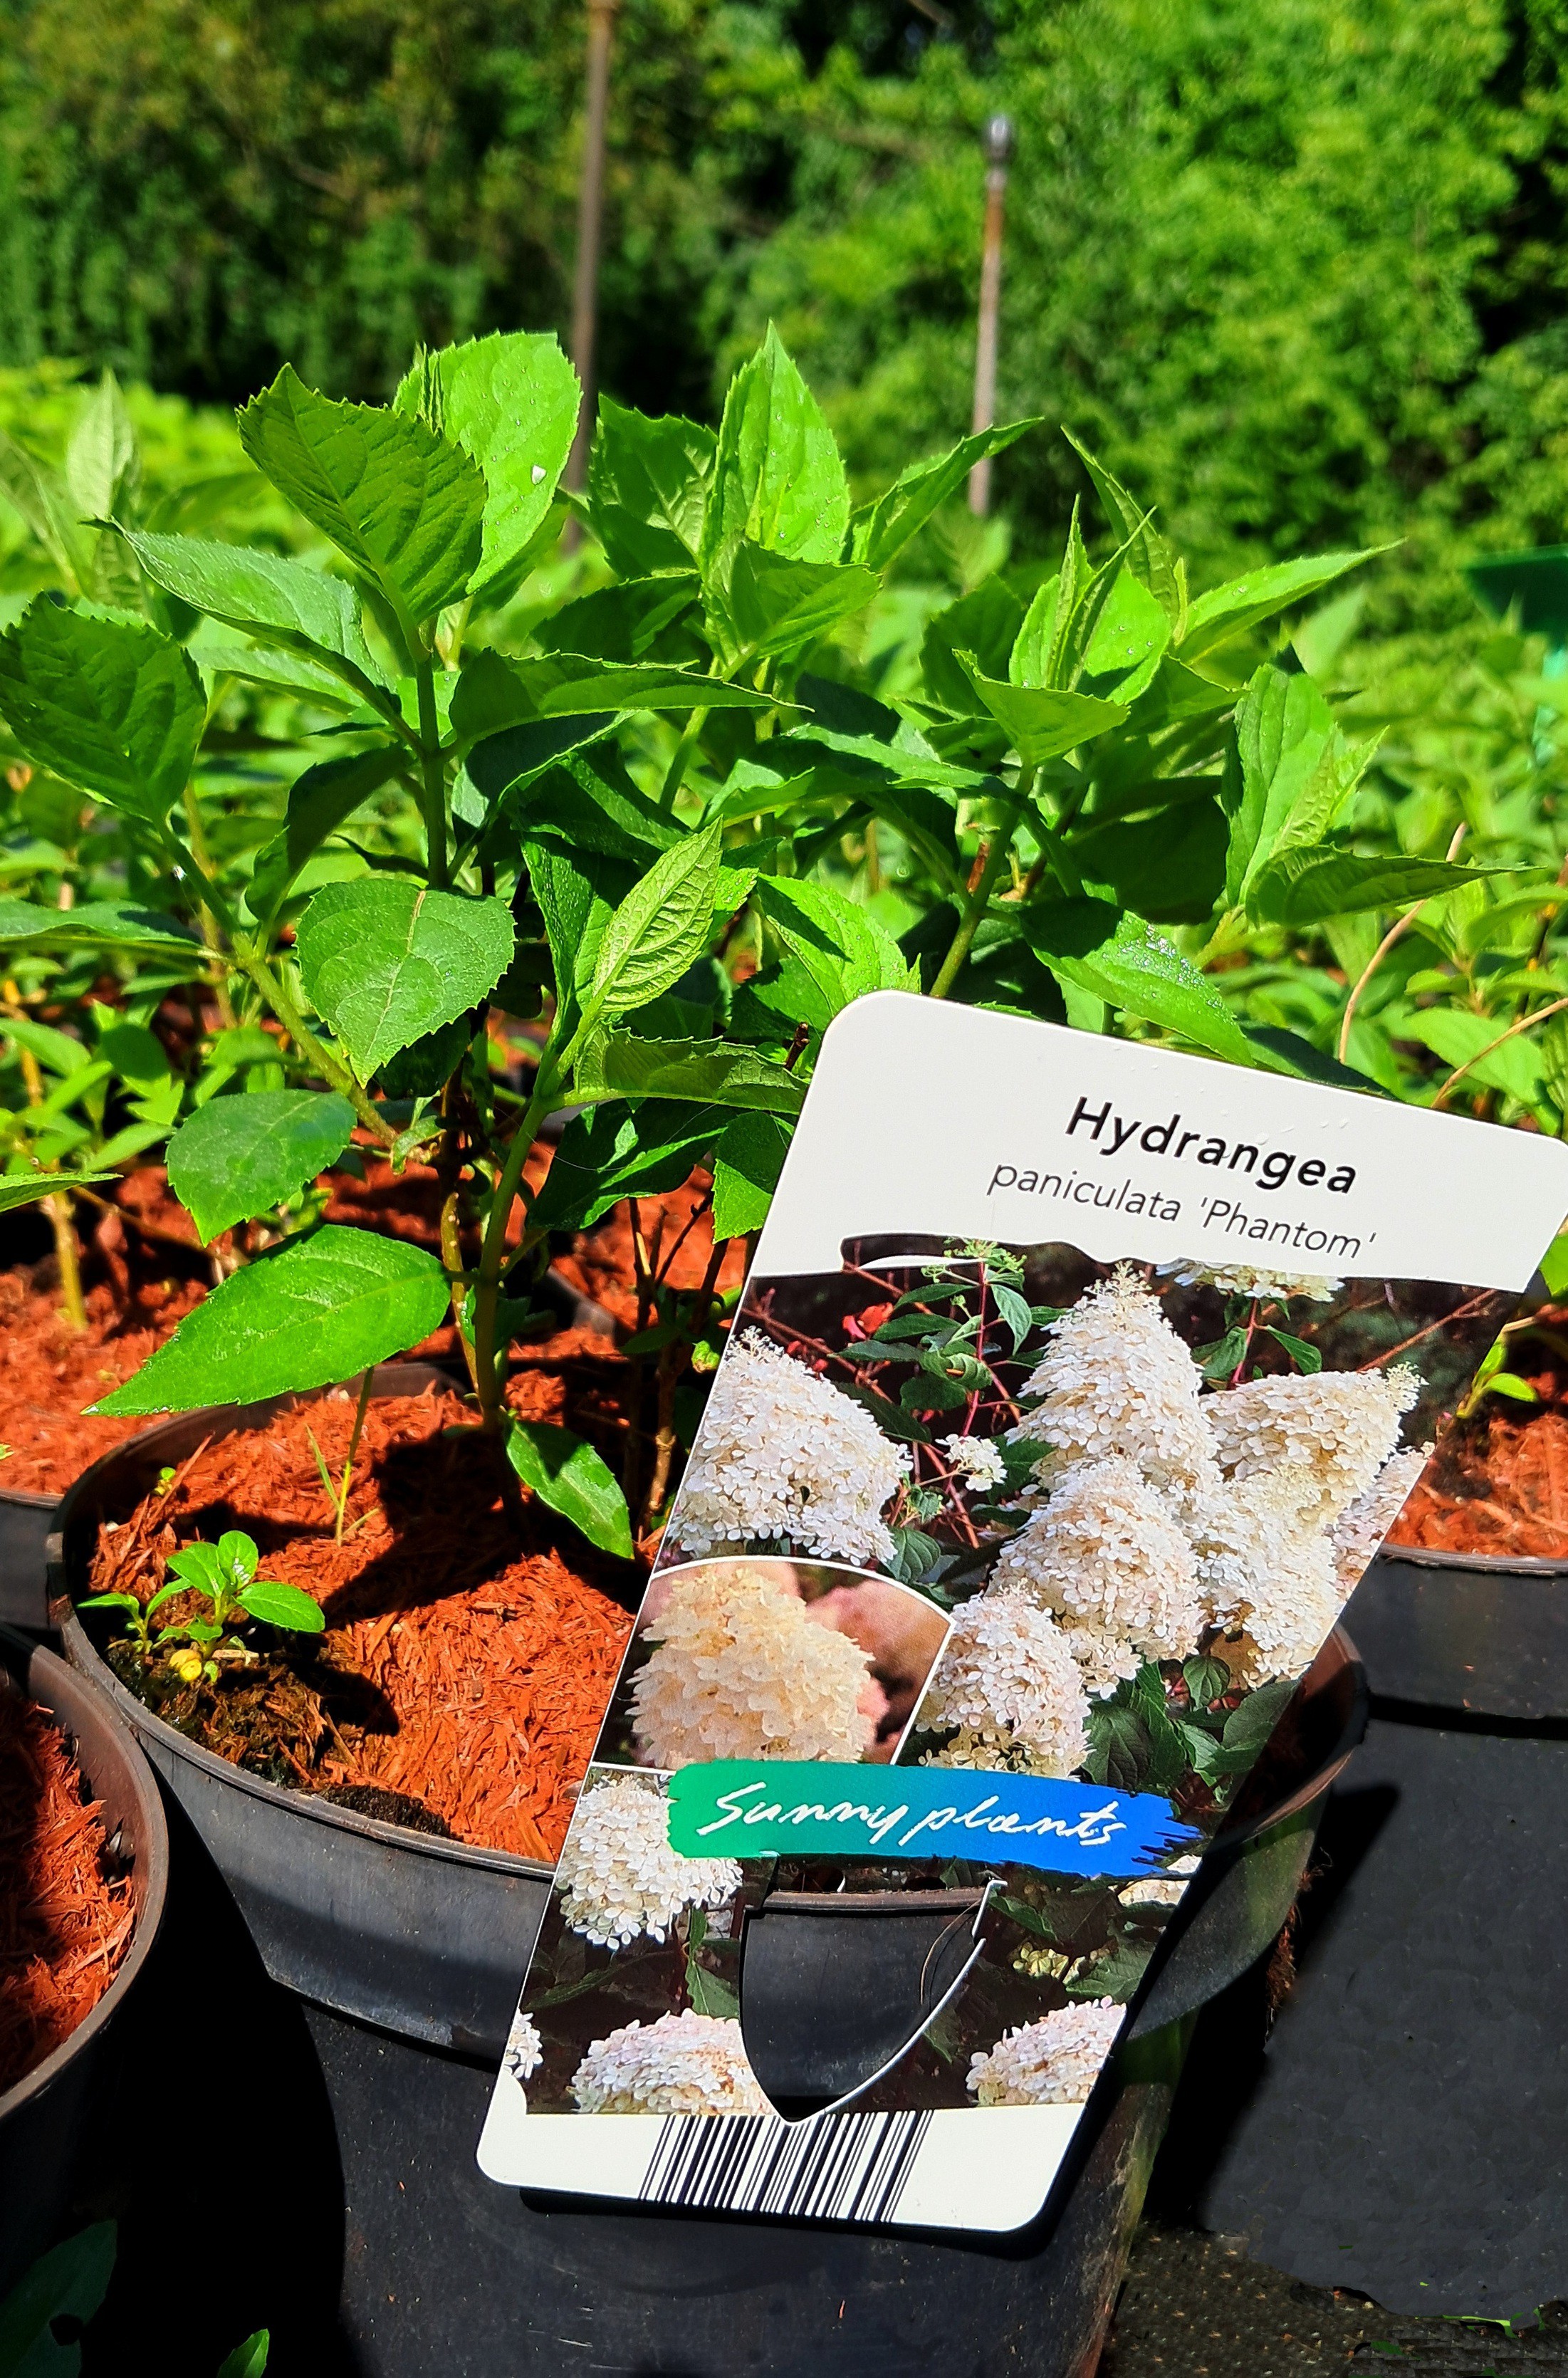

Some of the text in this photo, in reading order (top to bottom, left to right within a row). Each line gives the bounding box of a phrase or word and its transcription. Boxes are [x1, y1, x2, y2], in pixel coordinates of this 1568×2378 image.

[1065, 1096, 1357, 1194] Hydrangea
[986, 1163, 1376, 1259] paniculata 'Phantom'
[696, 1781, 1126, 1846] Sunny plants
